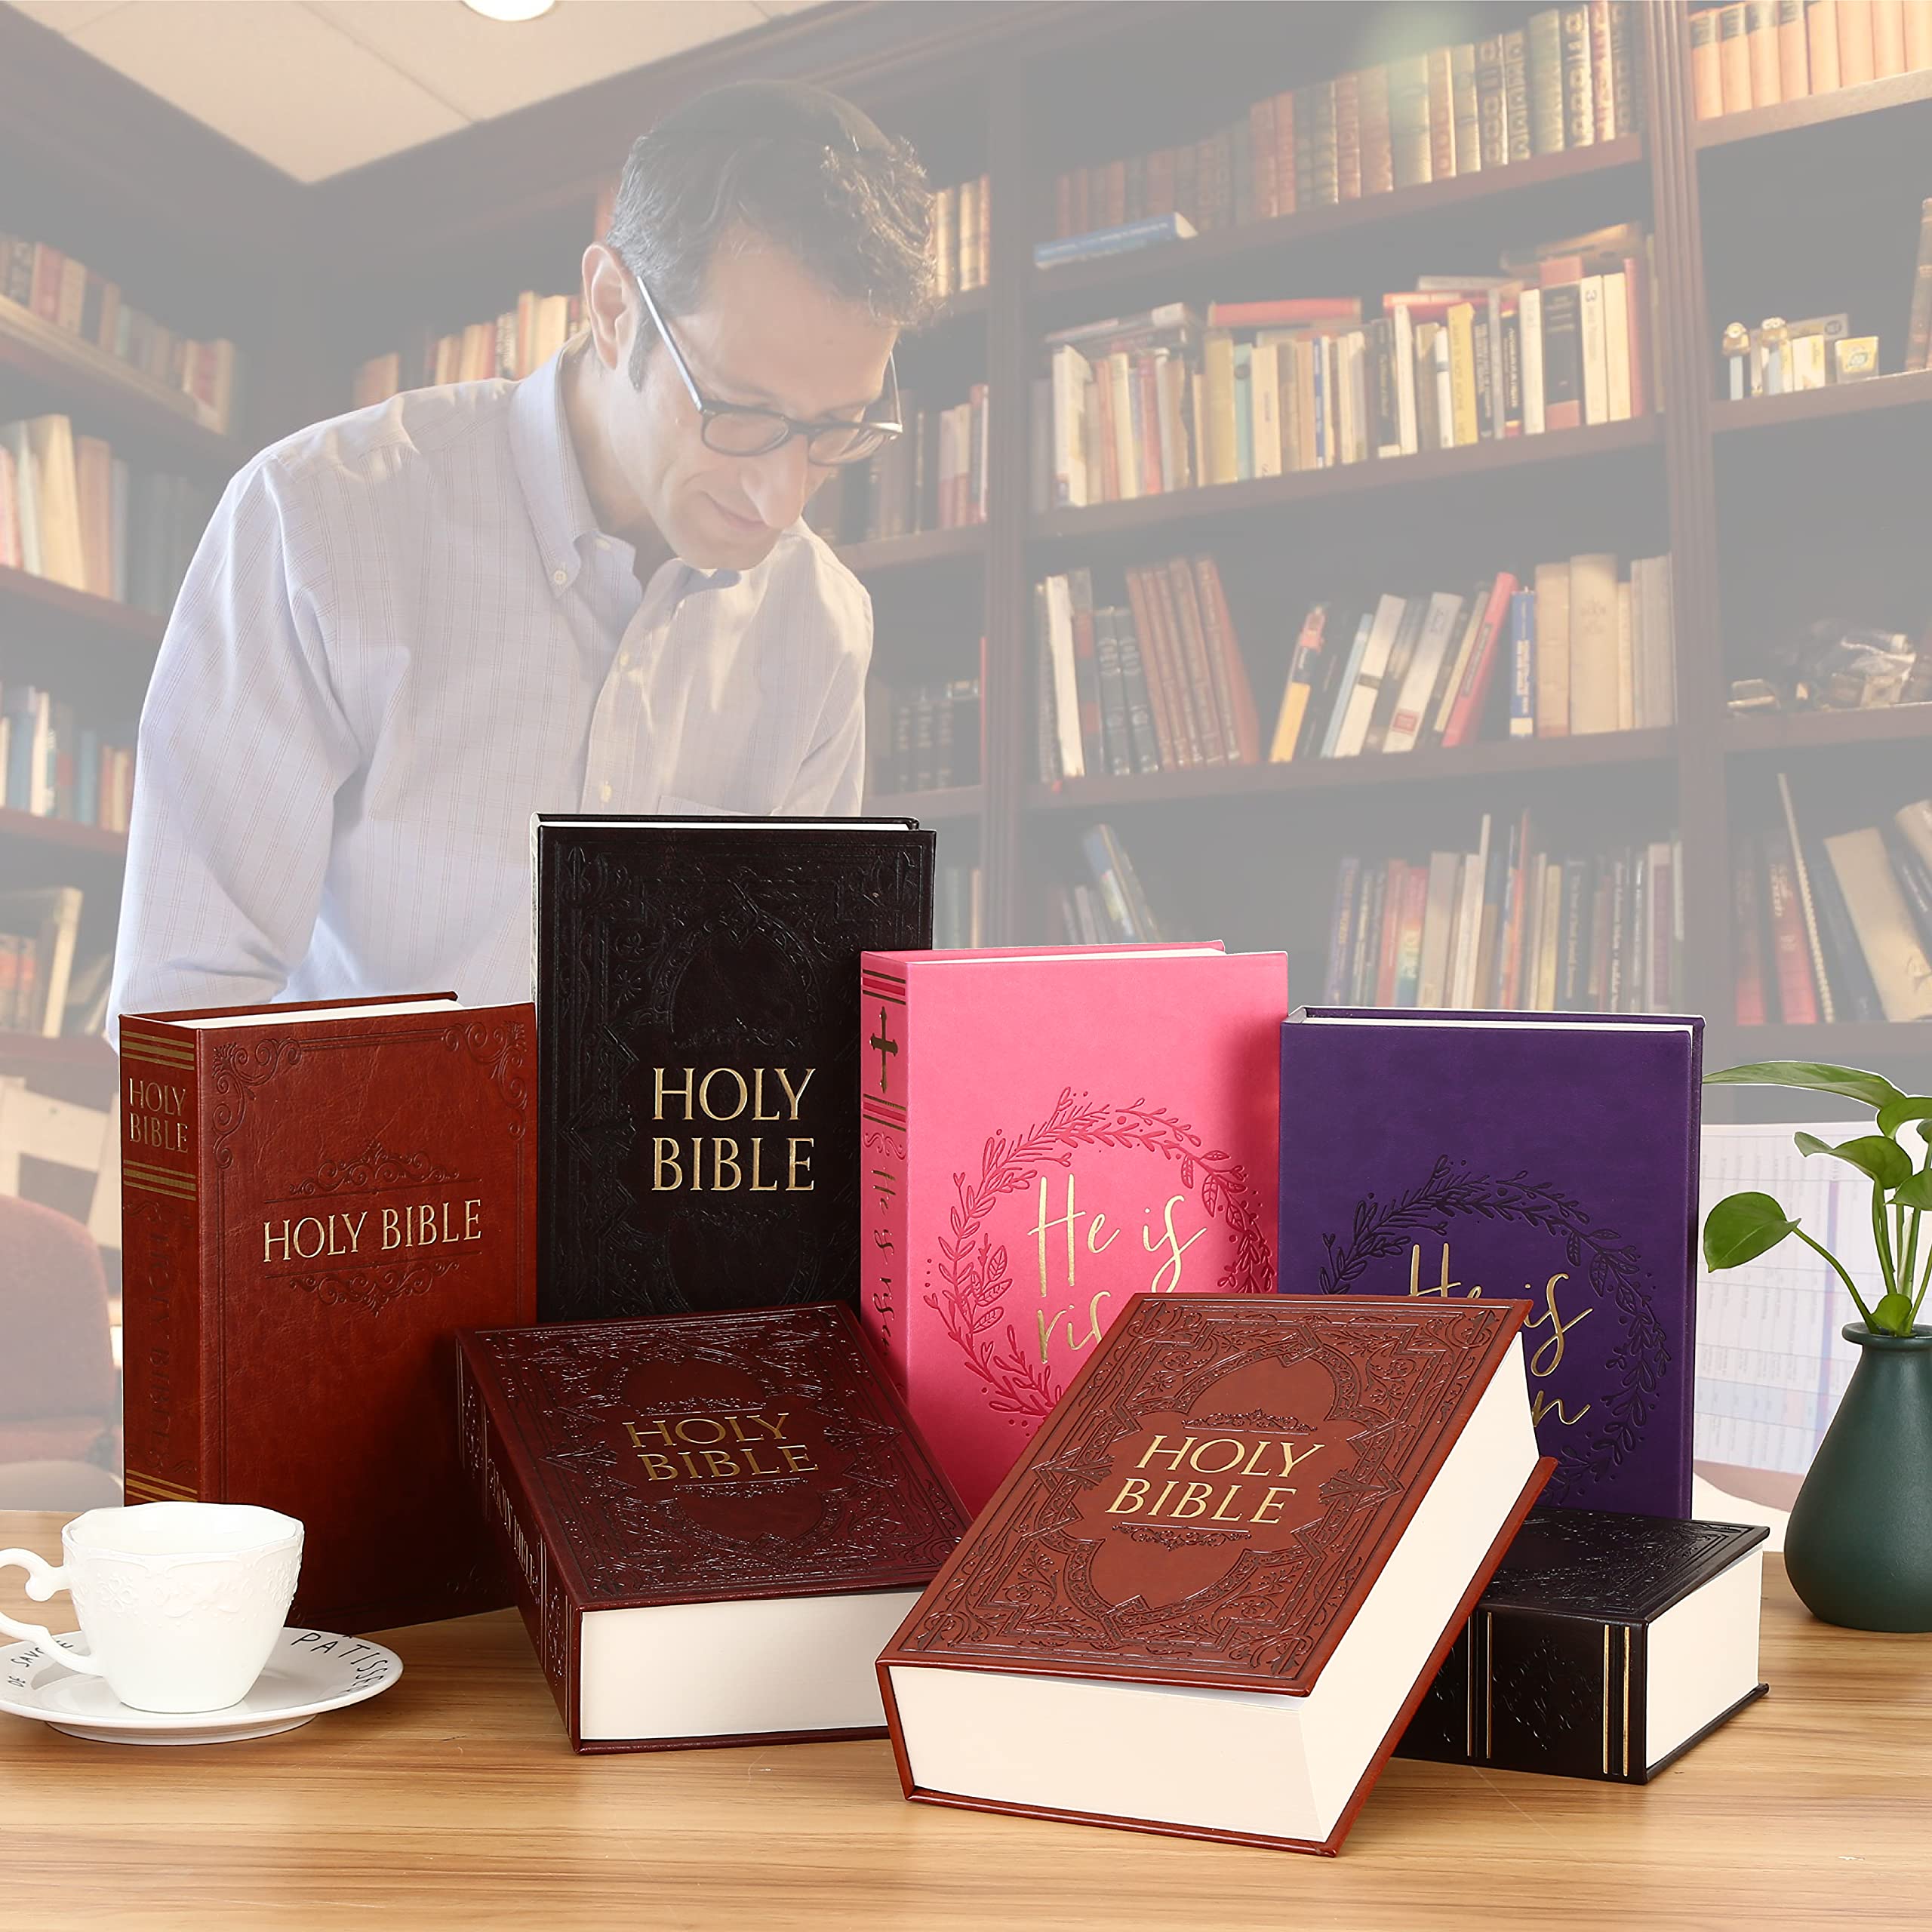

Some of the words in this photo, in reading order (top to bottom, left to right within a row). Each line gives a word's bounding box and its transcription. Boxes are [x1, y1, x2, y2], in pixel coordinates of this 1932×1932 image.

[128, 1078, 187, 1117] HOLY
[652, 1067, 816, 1121] HOLY
[129, 1113, 189, 1155] BIBLE
[652, 1137, 815, 1191] BIBLE
[872, 1168, 896, 1215] He
[263, 1211, 368, 1263] HOLY
[381, 1199, 481, 1251] BIBLE
[874, 1229, 894, 1264] is
[1027, 1174, 1121, 1297] He
[1143, 1195, 1207, 1293] is
[622, 1412, 790, 1448] HOLY
[638, 1444, 820, 1482] BIBLE
[1134, 1435, 1325, 1478] HOLY
[1105, 1477, 1297, 1524] BIBLE
[7, 1675, 26, 1688] DE
